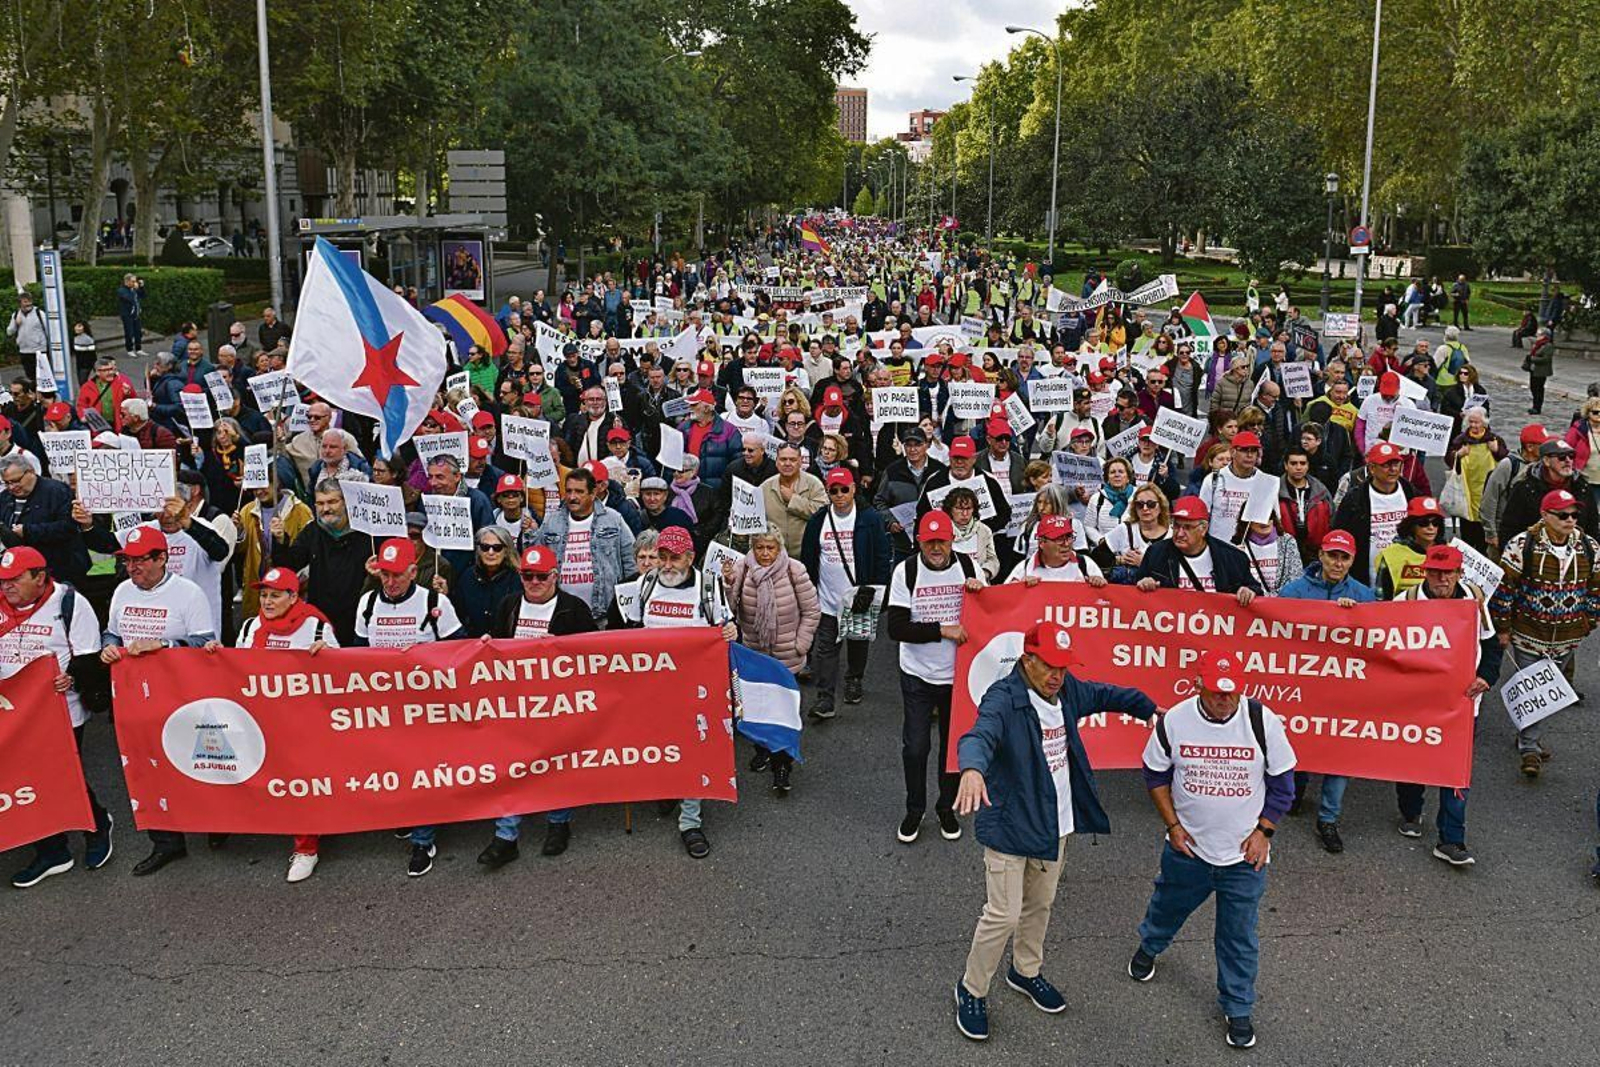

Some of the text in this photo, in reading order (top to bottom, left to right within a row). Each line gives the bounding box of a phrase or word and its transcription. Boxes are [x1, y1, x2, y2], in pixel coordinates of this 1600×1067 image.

[878, 392, 888, 403] YO
[1432, 421, 1451, 433] poder
[1111, 440, 1122, 450] YO
[77, 452, 170, 469] SANCHEZ
[81, 467, 158, 482] ESCRIVA
[88, 481, 164, 497] NO A LA
[126, 608, 165, 618] ASJUBI40
[377, 617, 416, 626] ASJUBI40
[1036, 606, 1452, 650] JUBILACIÓN ANTICIPADA
[1112, 644, 1367, 680] SIN PALIZAR
[241, 652, 677, 699] JUBILACIÓN ANTICIPADA
[1549, 686, 1567, 702] YO
[330, 690, 598, 731] SIN PENALIZAR
[1182, 747, 1252, 759] ASJUBI40
[193, 762, 237, 772] ASJUBI40
[267, 744, 682, 798] CON +40 AÑOS COTIZADOS
[1199, 771, 1250, 781] PENALIZAR
[1184, 782, 1253, 798] COTIZADOS
